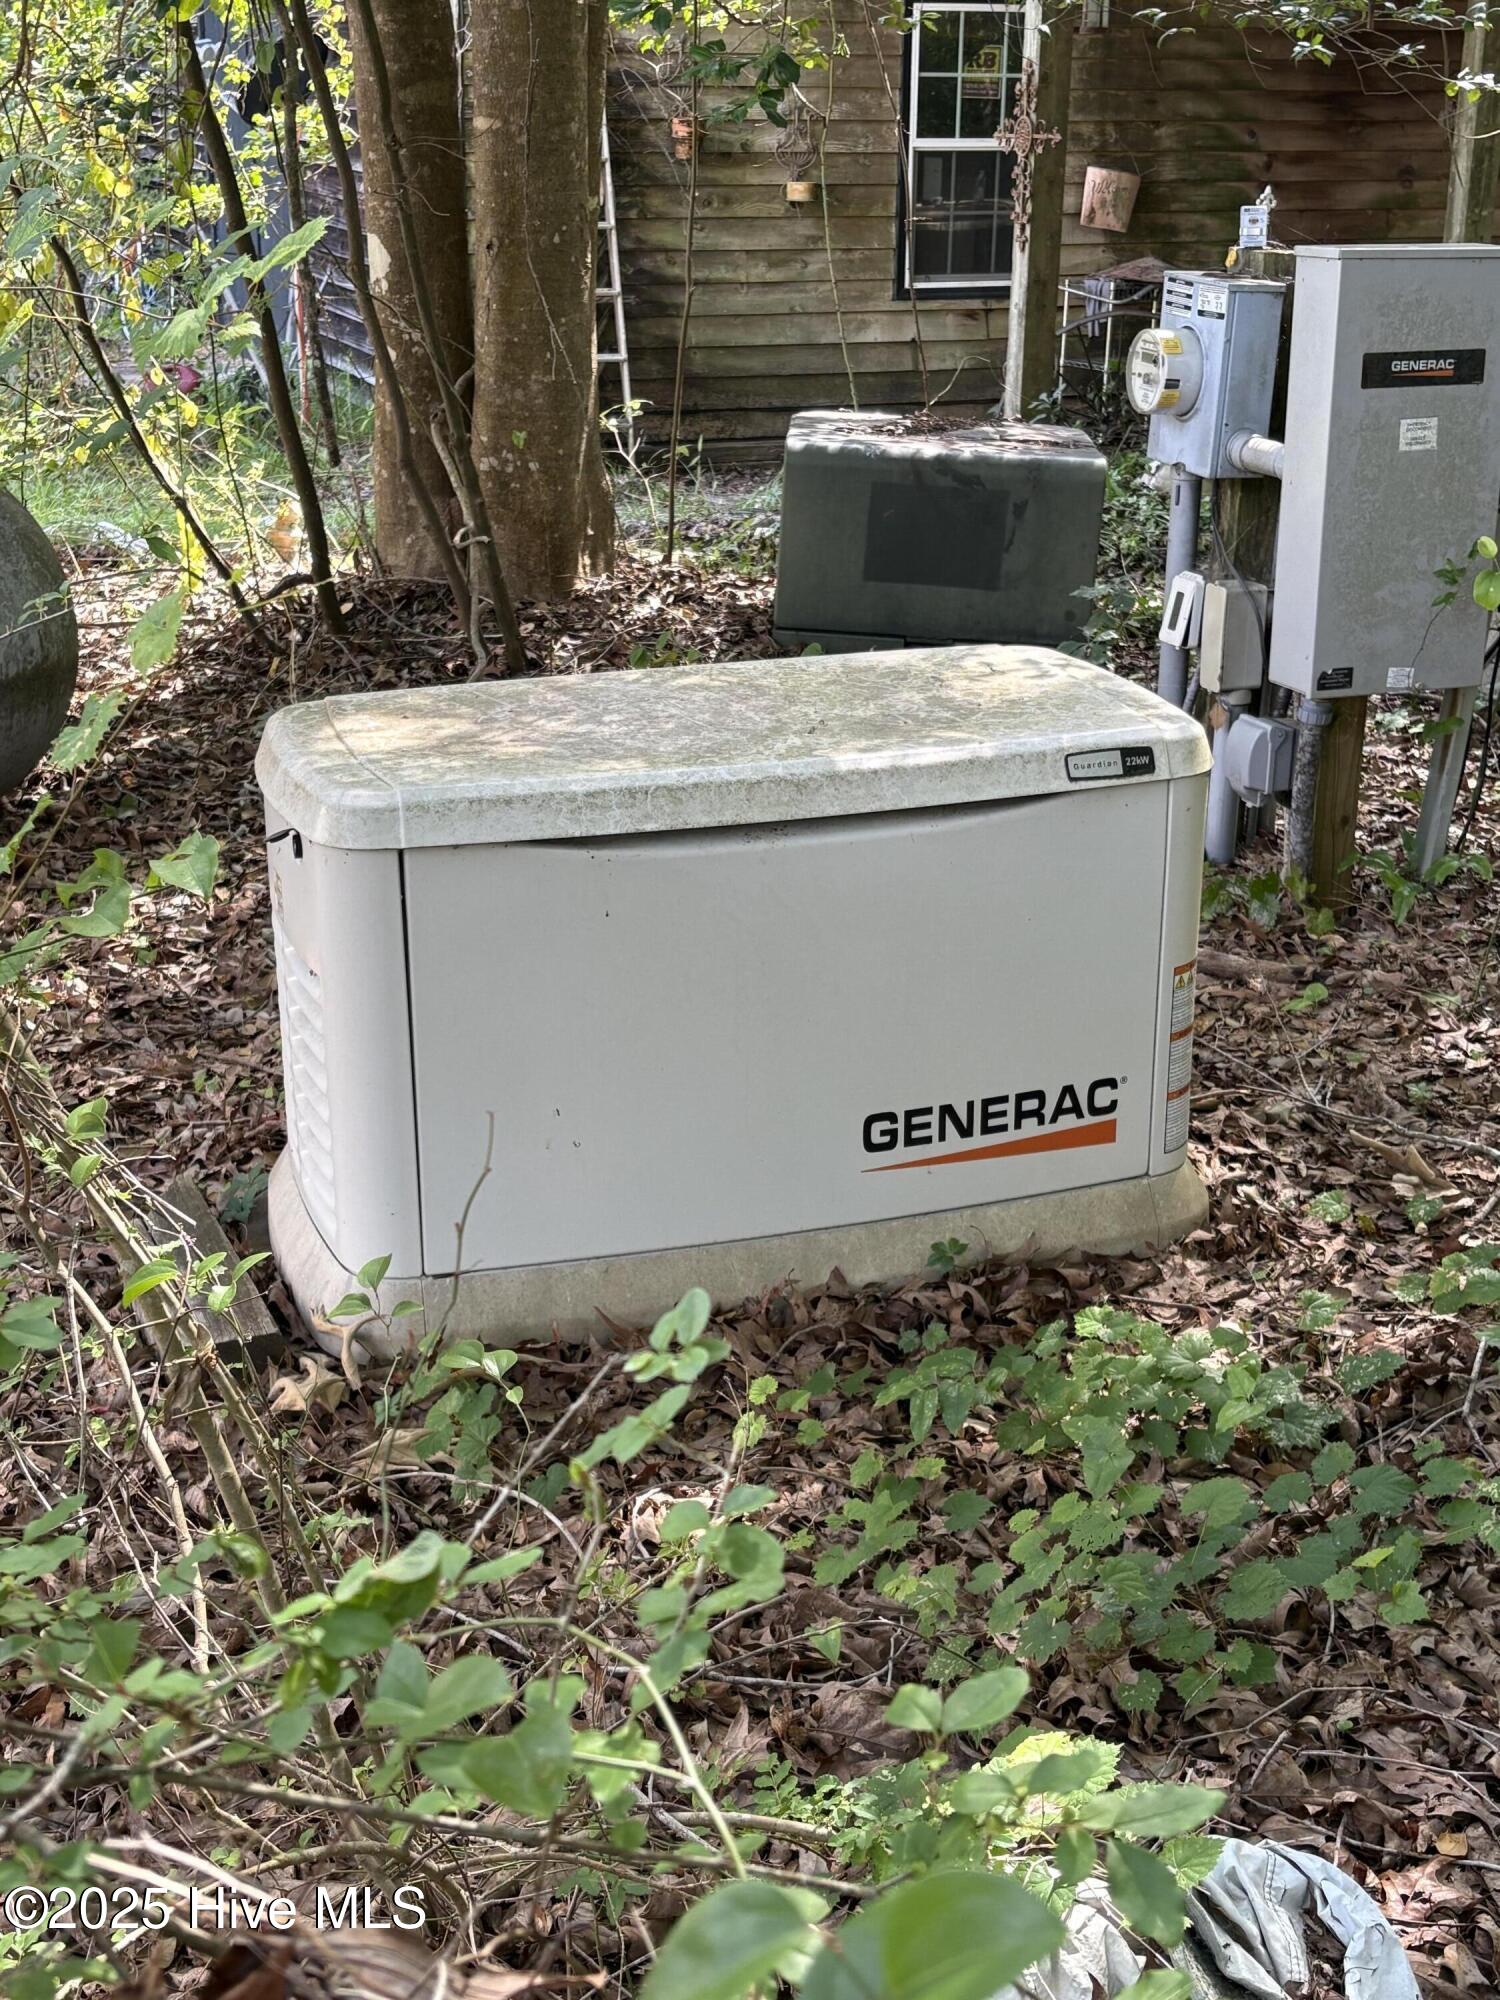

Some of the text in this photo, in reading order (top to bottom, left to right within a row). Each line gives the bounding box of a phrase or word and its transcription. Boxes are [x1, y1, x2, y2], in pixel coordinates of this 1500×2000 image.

[1391, 358, 1456, 372] GENERAC
[1073, 755, 1150, 770] Guardian 22kW
